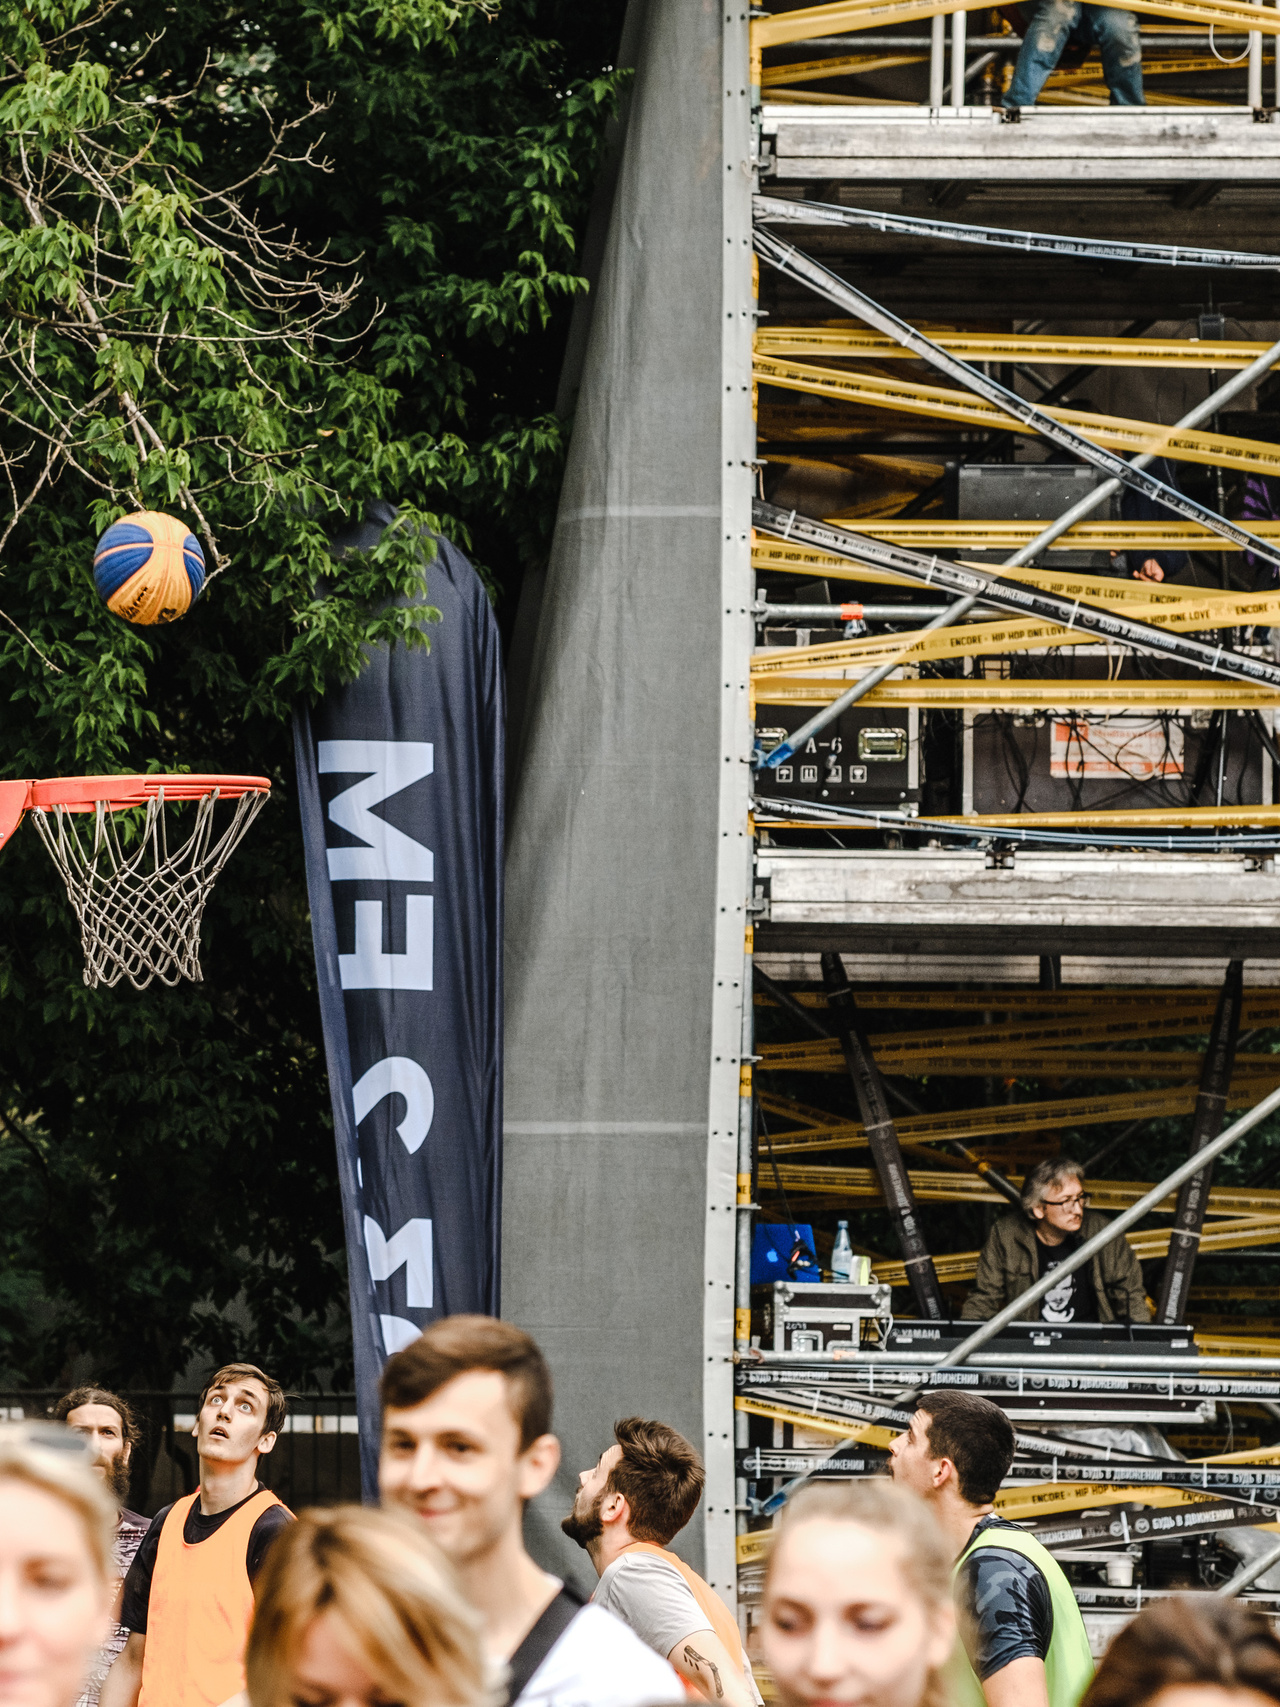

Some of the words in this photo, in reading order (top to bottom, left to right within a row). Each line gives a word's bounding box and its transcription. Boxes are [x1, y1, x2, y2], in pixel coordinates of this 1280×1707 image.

[1167, 437, 1199, 451] ENCORE
[1261, 455, 1279, 466] LOV
[785, 552, 801, 561] HOP
[1050, 583, 1063, 592] HIP
[1066, 584, 1082, 594] HOP
[1085, 587, 1100, 596] ONE
[1104, 589, 1125, 599] LOVE
[1235, 603, 1267, 614] ENCORE
[1151, 614, 1167, 623] HOP
[1170, 612, 1184, 621] ONE
[1188, 610, 1210, 620] LOVE
[949, 635, 981, 646] ENCORE
[991, 632, 1005, 642] HIP
[1007, 630, 1024, 640] HOP
[1026, 628, 1043, 638] ONE
[1045, 626, 1066, 636] LOVE
[805, 736, 843, 754] A-6
[901, 1329, 940, 1339] YAMAHA
[898, 1372, 920, 1384] БУДЬ
[921, 1372, 928, 1383] В
[1047, 1376, 1070, 1388] БУДЬ
[1071, 1377, 1078, 1387] В
[1081, 1468, 1104, 1478] БУДЬ
[1105, 1468, 1111, 1479] В
[1232, 1473, 1254, 1484] БУДЬ
[1255, 1474, 1262, 1484] В
[1031, 1491, 1065, 1503] ENCORE
[1075, 1488, 1088, 1497] HIP
[1092, 1484, 1109, 1495] HOP
[1151, 1515, 1175, 1530] БУДЬ
[1175, 1514, 1183, 1526] В
[1183, 1508, 1234, 1526] ДВИЖЕНИИ
